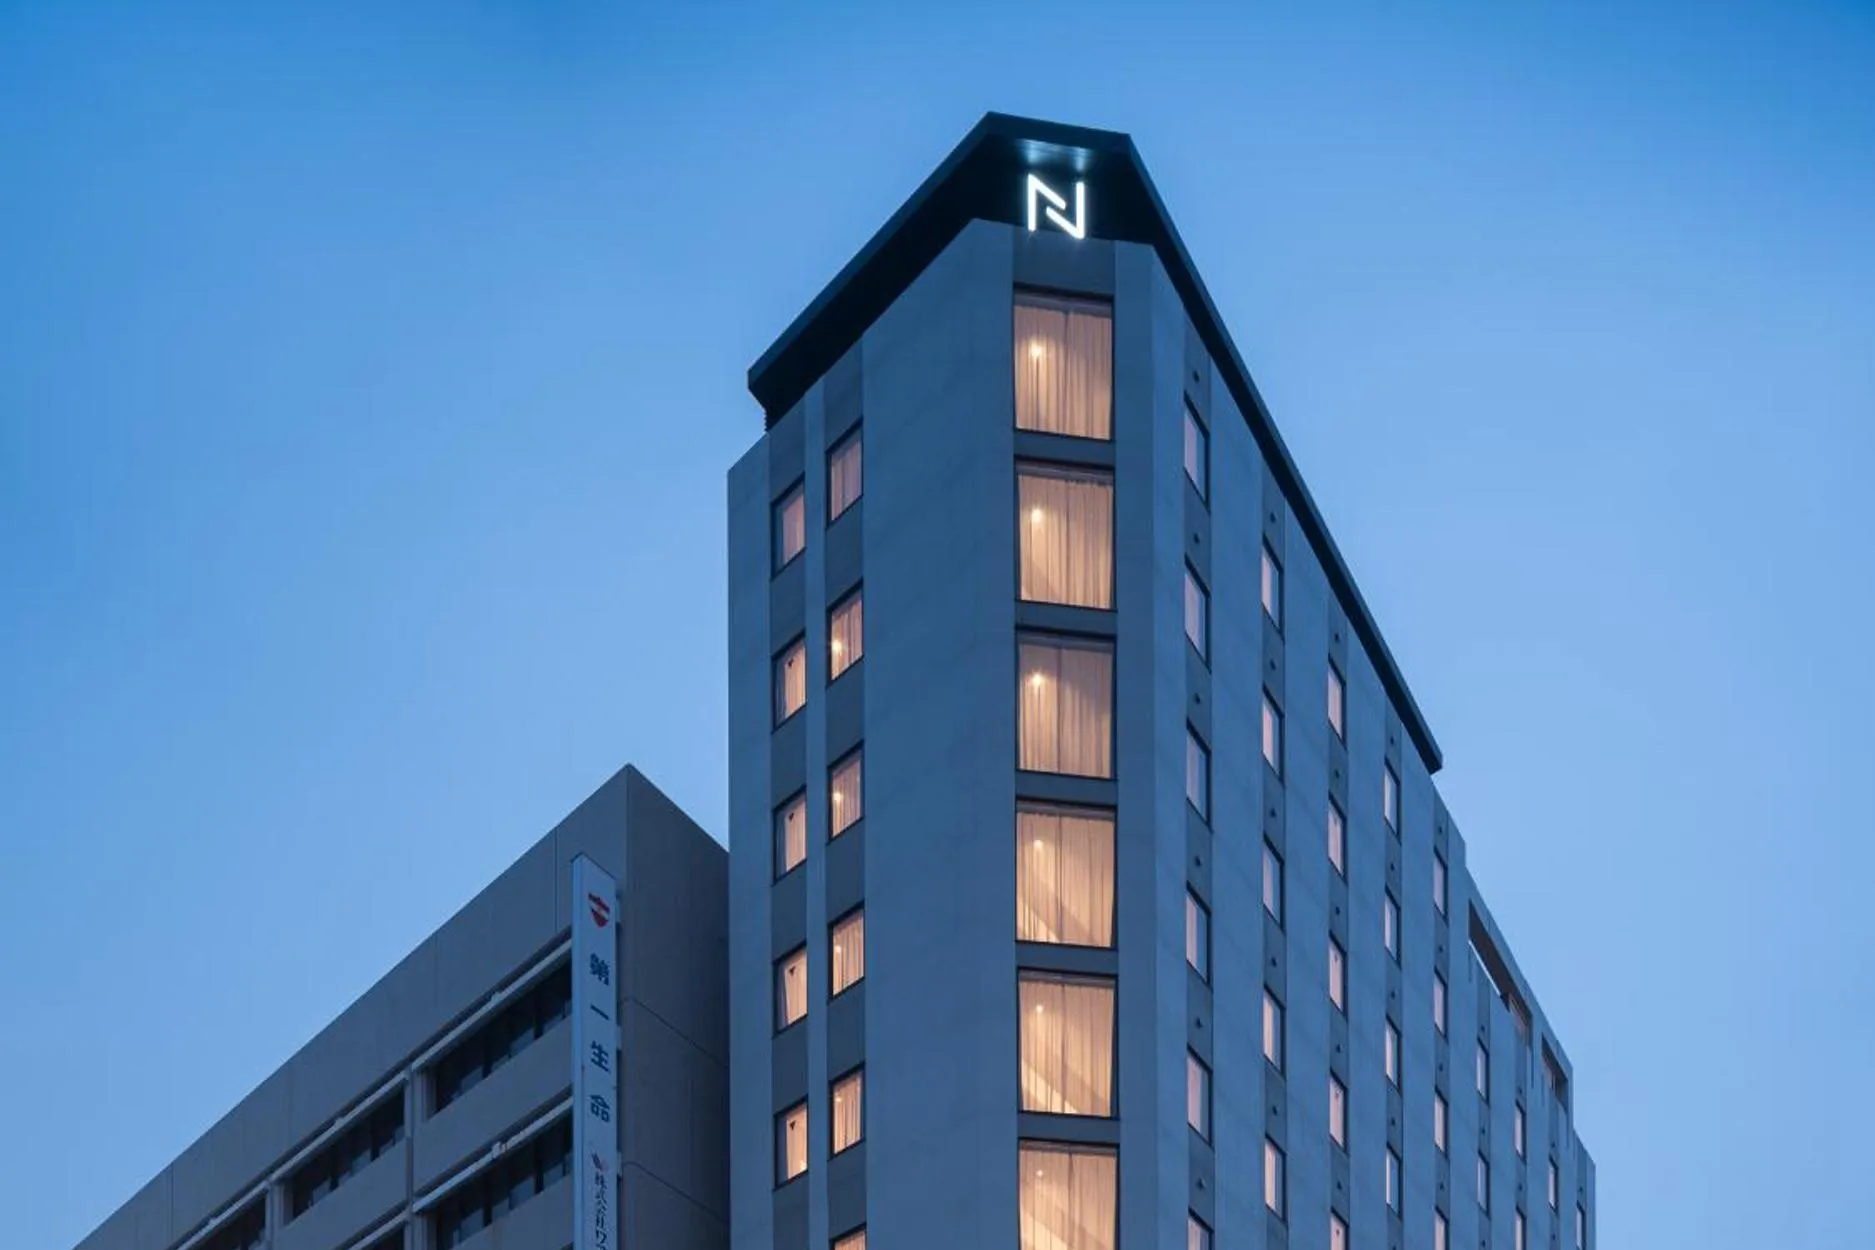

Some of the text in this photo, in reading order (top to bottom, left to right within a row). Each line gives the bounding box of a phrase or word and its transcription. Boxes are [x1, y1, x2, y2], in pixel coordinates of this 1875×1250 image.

[1027, 172, 1085, 240] N
[589, 953, 611, 1124] 第一生命
